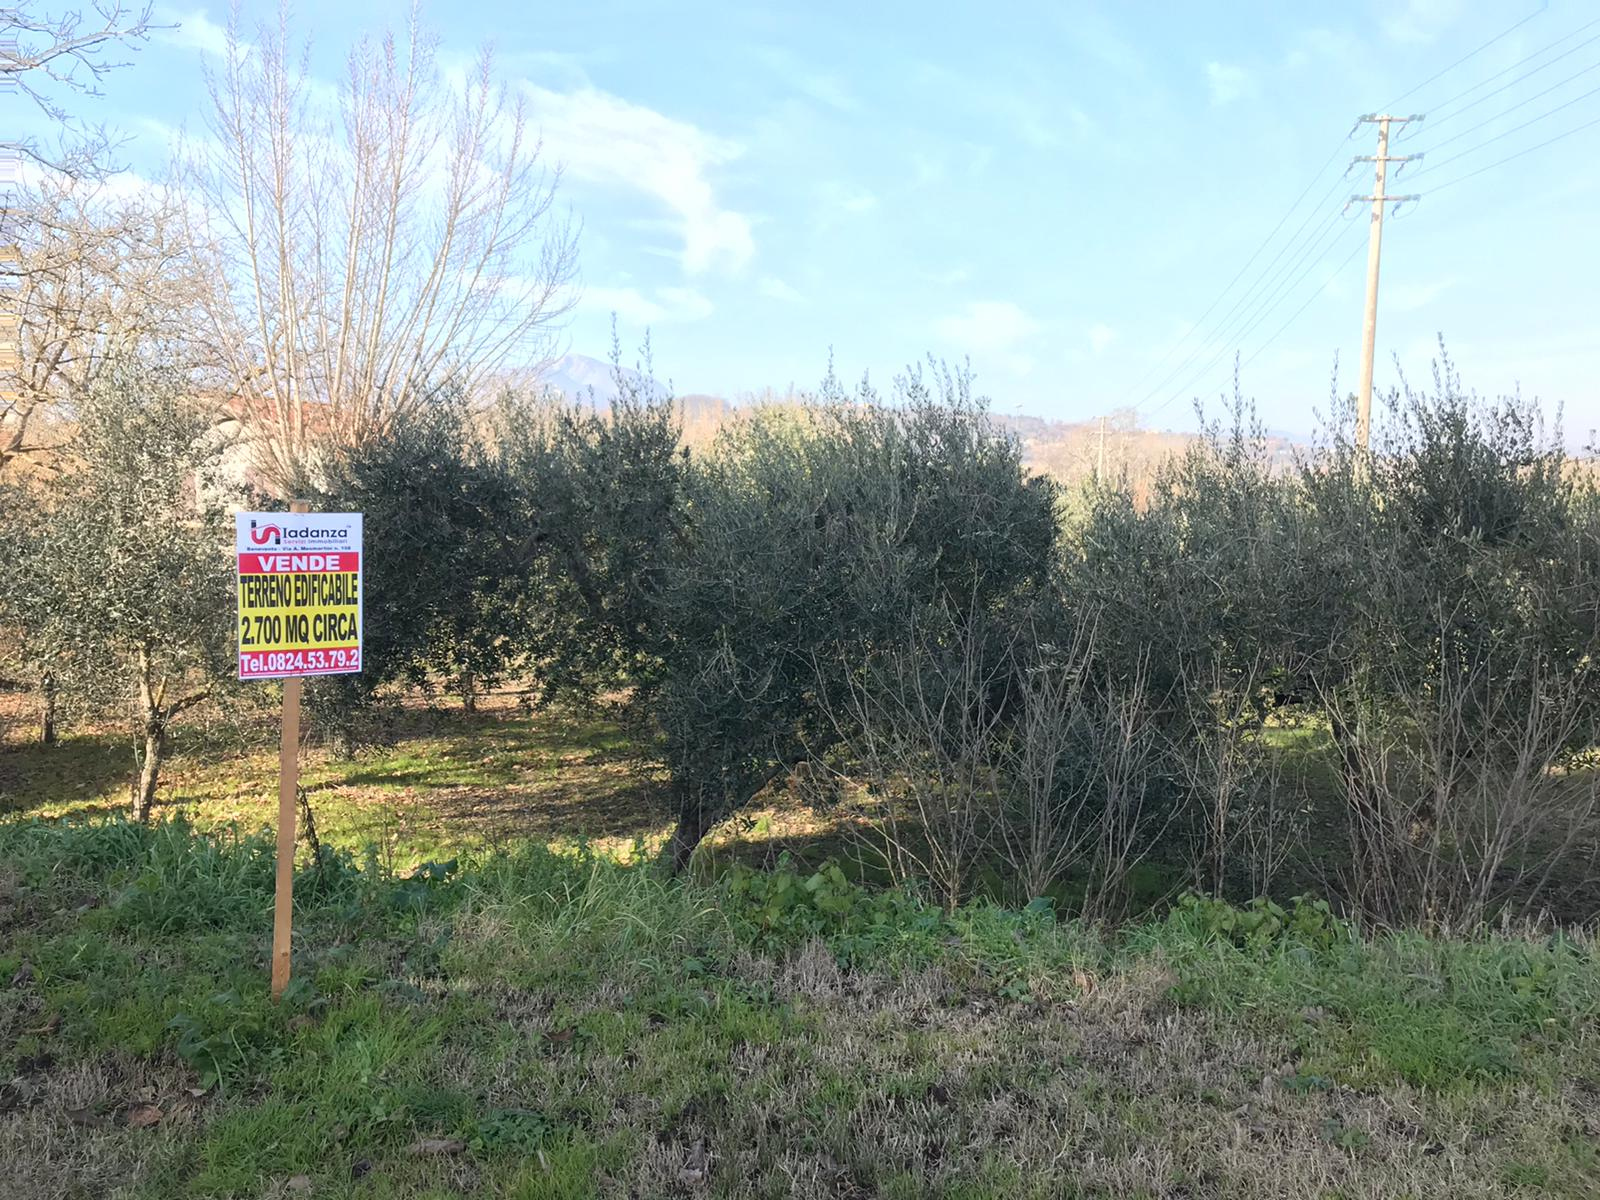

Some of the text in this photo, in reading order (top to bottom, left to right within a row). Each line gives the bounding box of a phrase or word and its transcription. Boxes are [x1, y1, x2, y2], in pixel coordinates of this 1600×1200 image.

[283, 527, 347, 538] Iadanza
[258, 555, 340, 572] VENDE
[240, 573, 358, 608] TERRENO EDIFICABILE
[242, 613, 358, 645] 2.700 MQ CIRCA
[240, 649, 358, 673] Tel.0824.53.79.2
